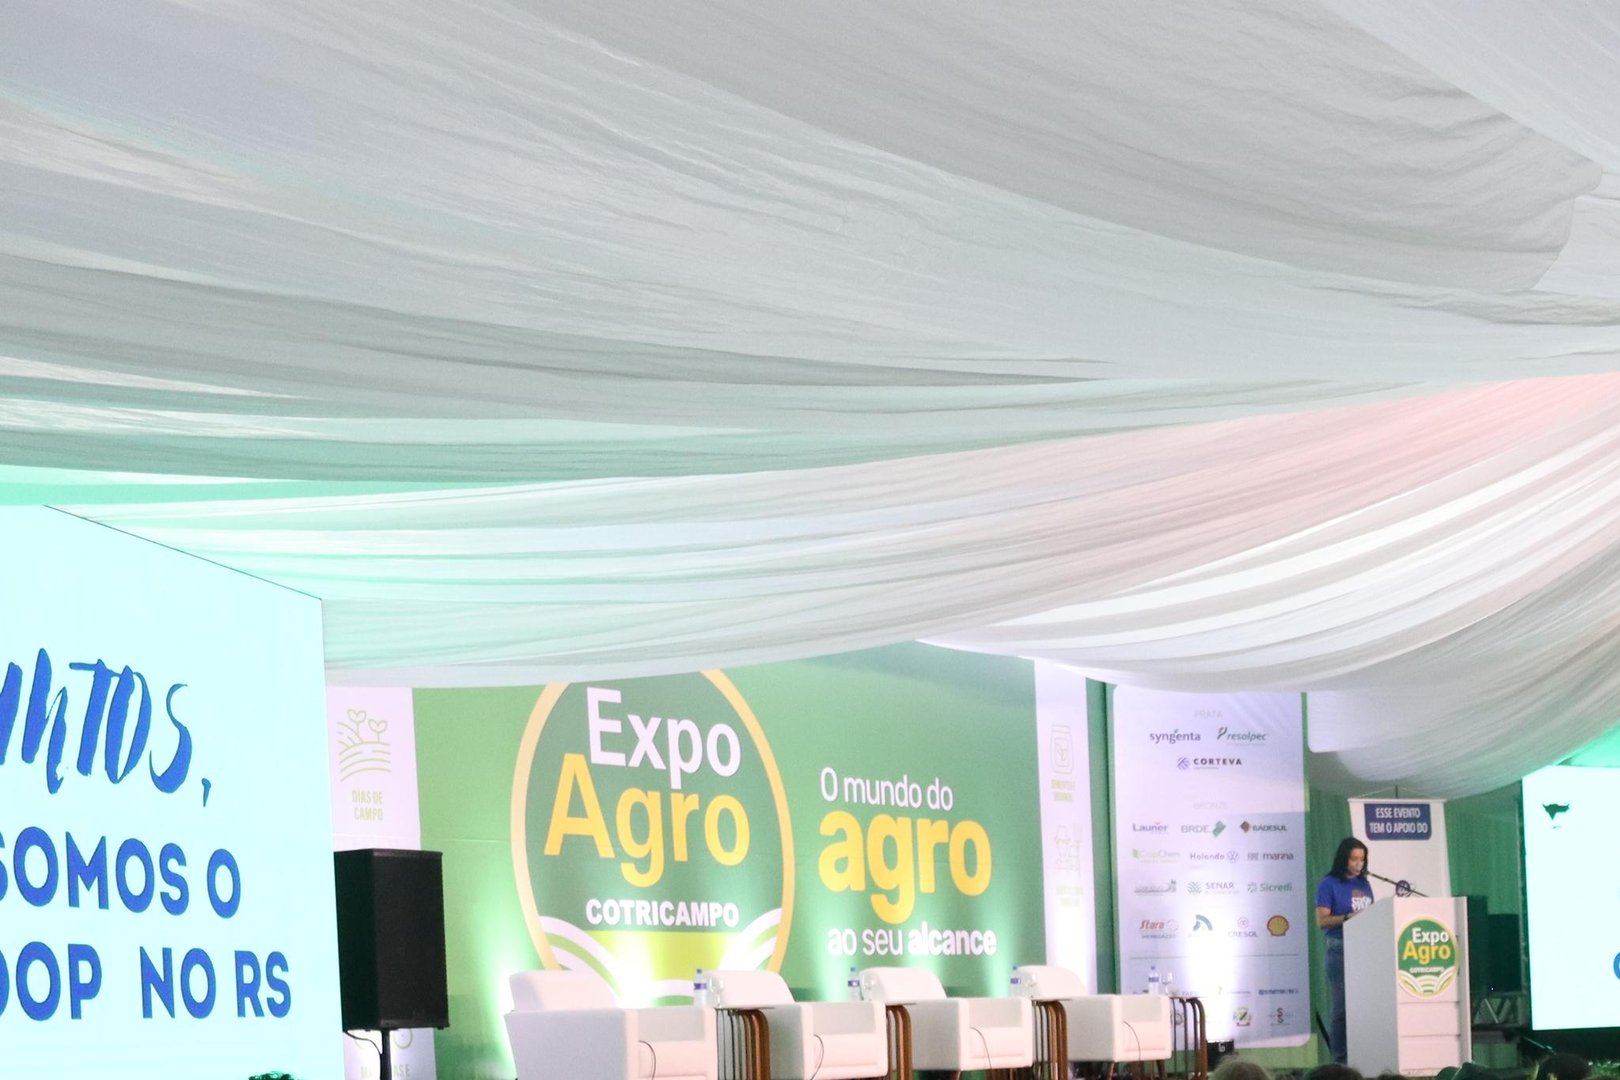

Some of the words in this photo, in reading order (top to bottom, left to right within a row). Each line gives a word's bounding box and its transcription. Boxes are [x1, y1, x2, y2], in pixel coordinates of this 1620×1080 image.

[587, 686, 741, 790] Expo
[1150, 729, 1201, 744] syngenta
[820, 767, 838, 801] O
[844, 775, 922, 808] mundo
[926, 777, 953, 811] do
[544, 752, 751, 888] Agro
[1375, 807, 1393, 818] ESSE
[1394, 807, 1420, 818] EVENTO
[1369, 823, 1385, 834] TEM
[1386, 823, 1392, 834] O
[1393, 822, 1416, 834] APOIO
[1417, 822, 1428, 833] DO
[0, 826, 189, 916] OMOS
[207, 849, 241, 919] O
[818, 810, 992, 925] agro
[1205, 882, 1235, 890] SENAR
[1259, 882, 1293, 892] Sicredi
[585, 898, 740, 928] COTRICAMPO
[1139, 919, 1165, 930] Stara
[827, 927, 857, 956] ao
[862, 927, 903, 956] seu
[908, 921, 997, 956] alcance
[1411, 927, 1449, 946] Expo
[1402, 941, 1451, 966] Agro
[140, 946, 216, 1020] NO
[234, 950, 292, 1018] RS
